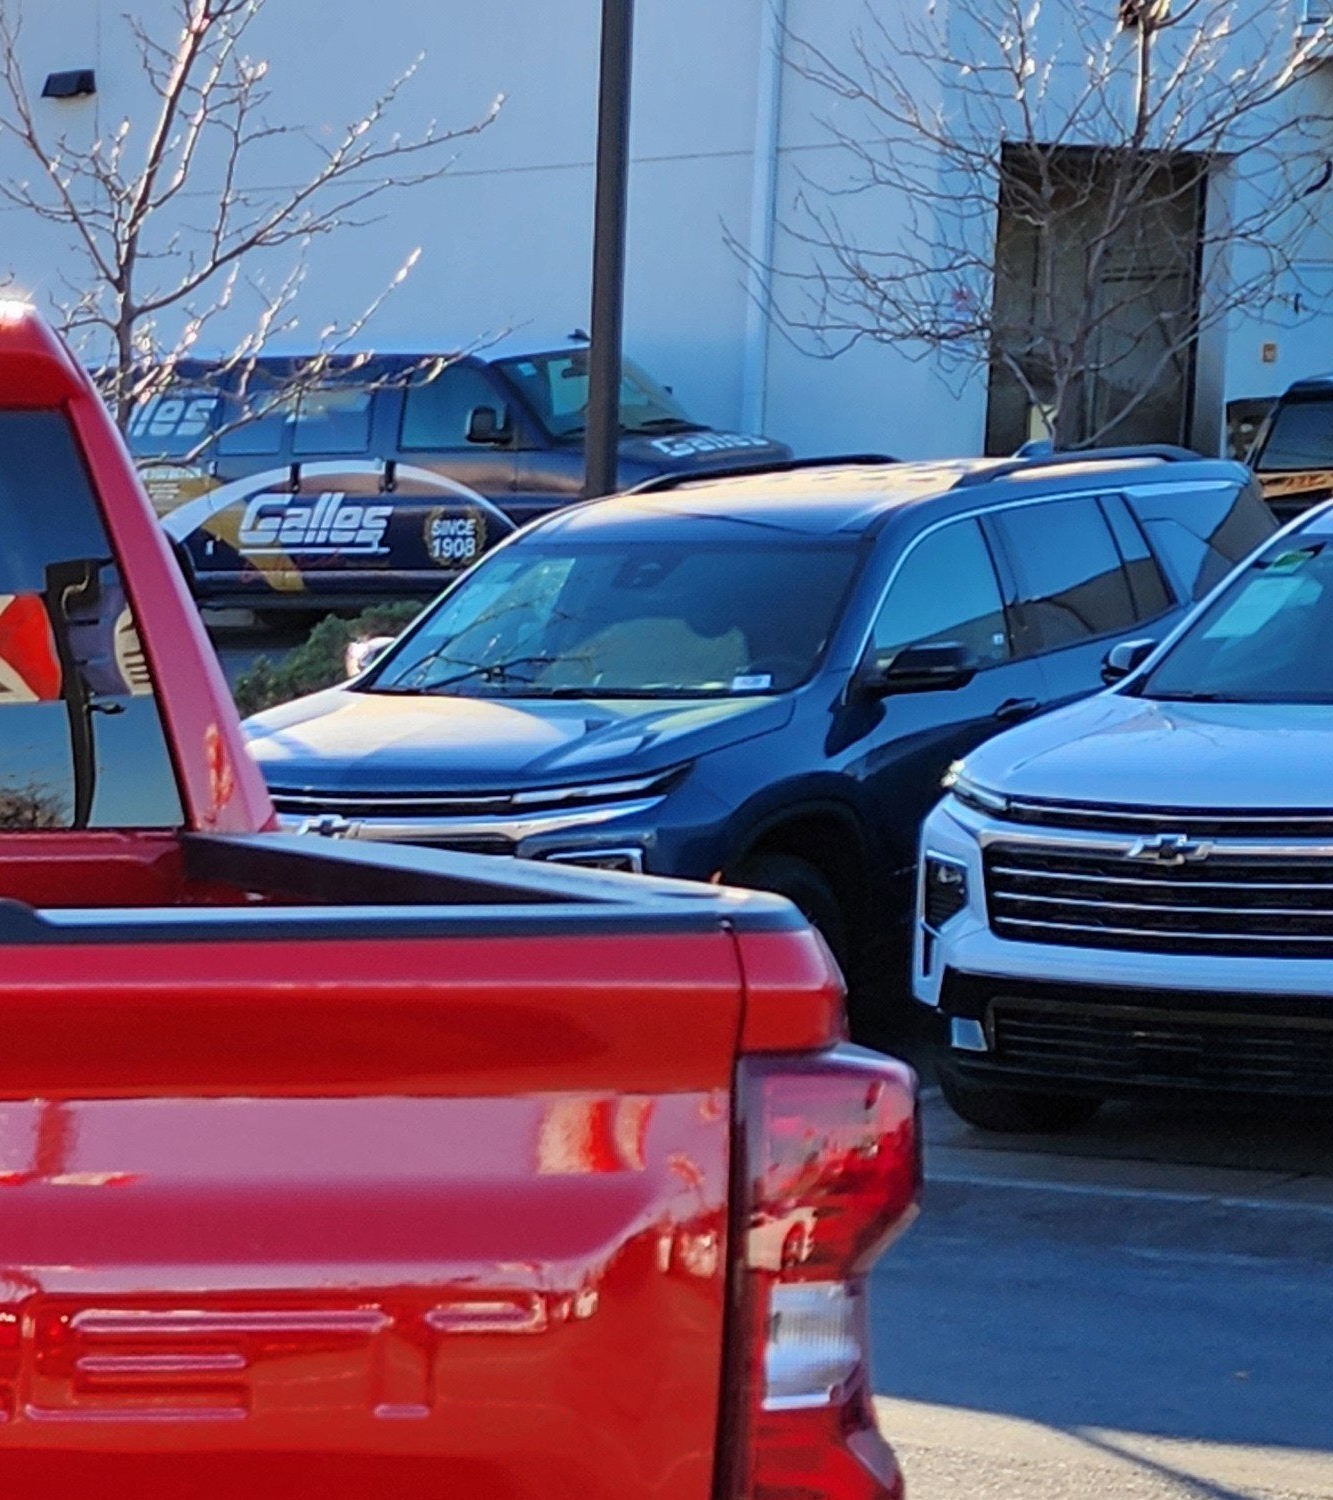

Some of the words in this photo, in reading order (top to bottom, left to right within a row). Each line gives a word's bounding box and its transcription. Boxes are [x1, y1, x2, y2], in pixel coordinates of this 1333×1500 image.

[238, 492, 394, 545] Galles
[431, 518, 476, 536] SINCE
[431, 538, 476, 559] 1908
